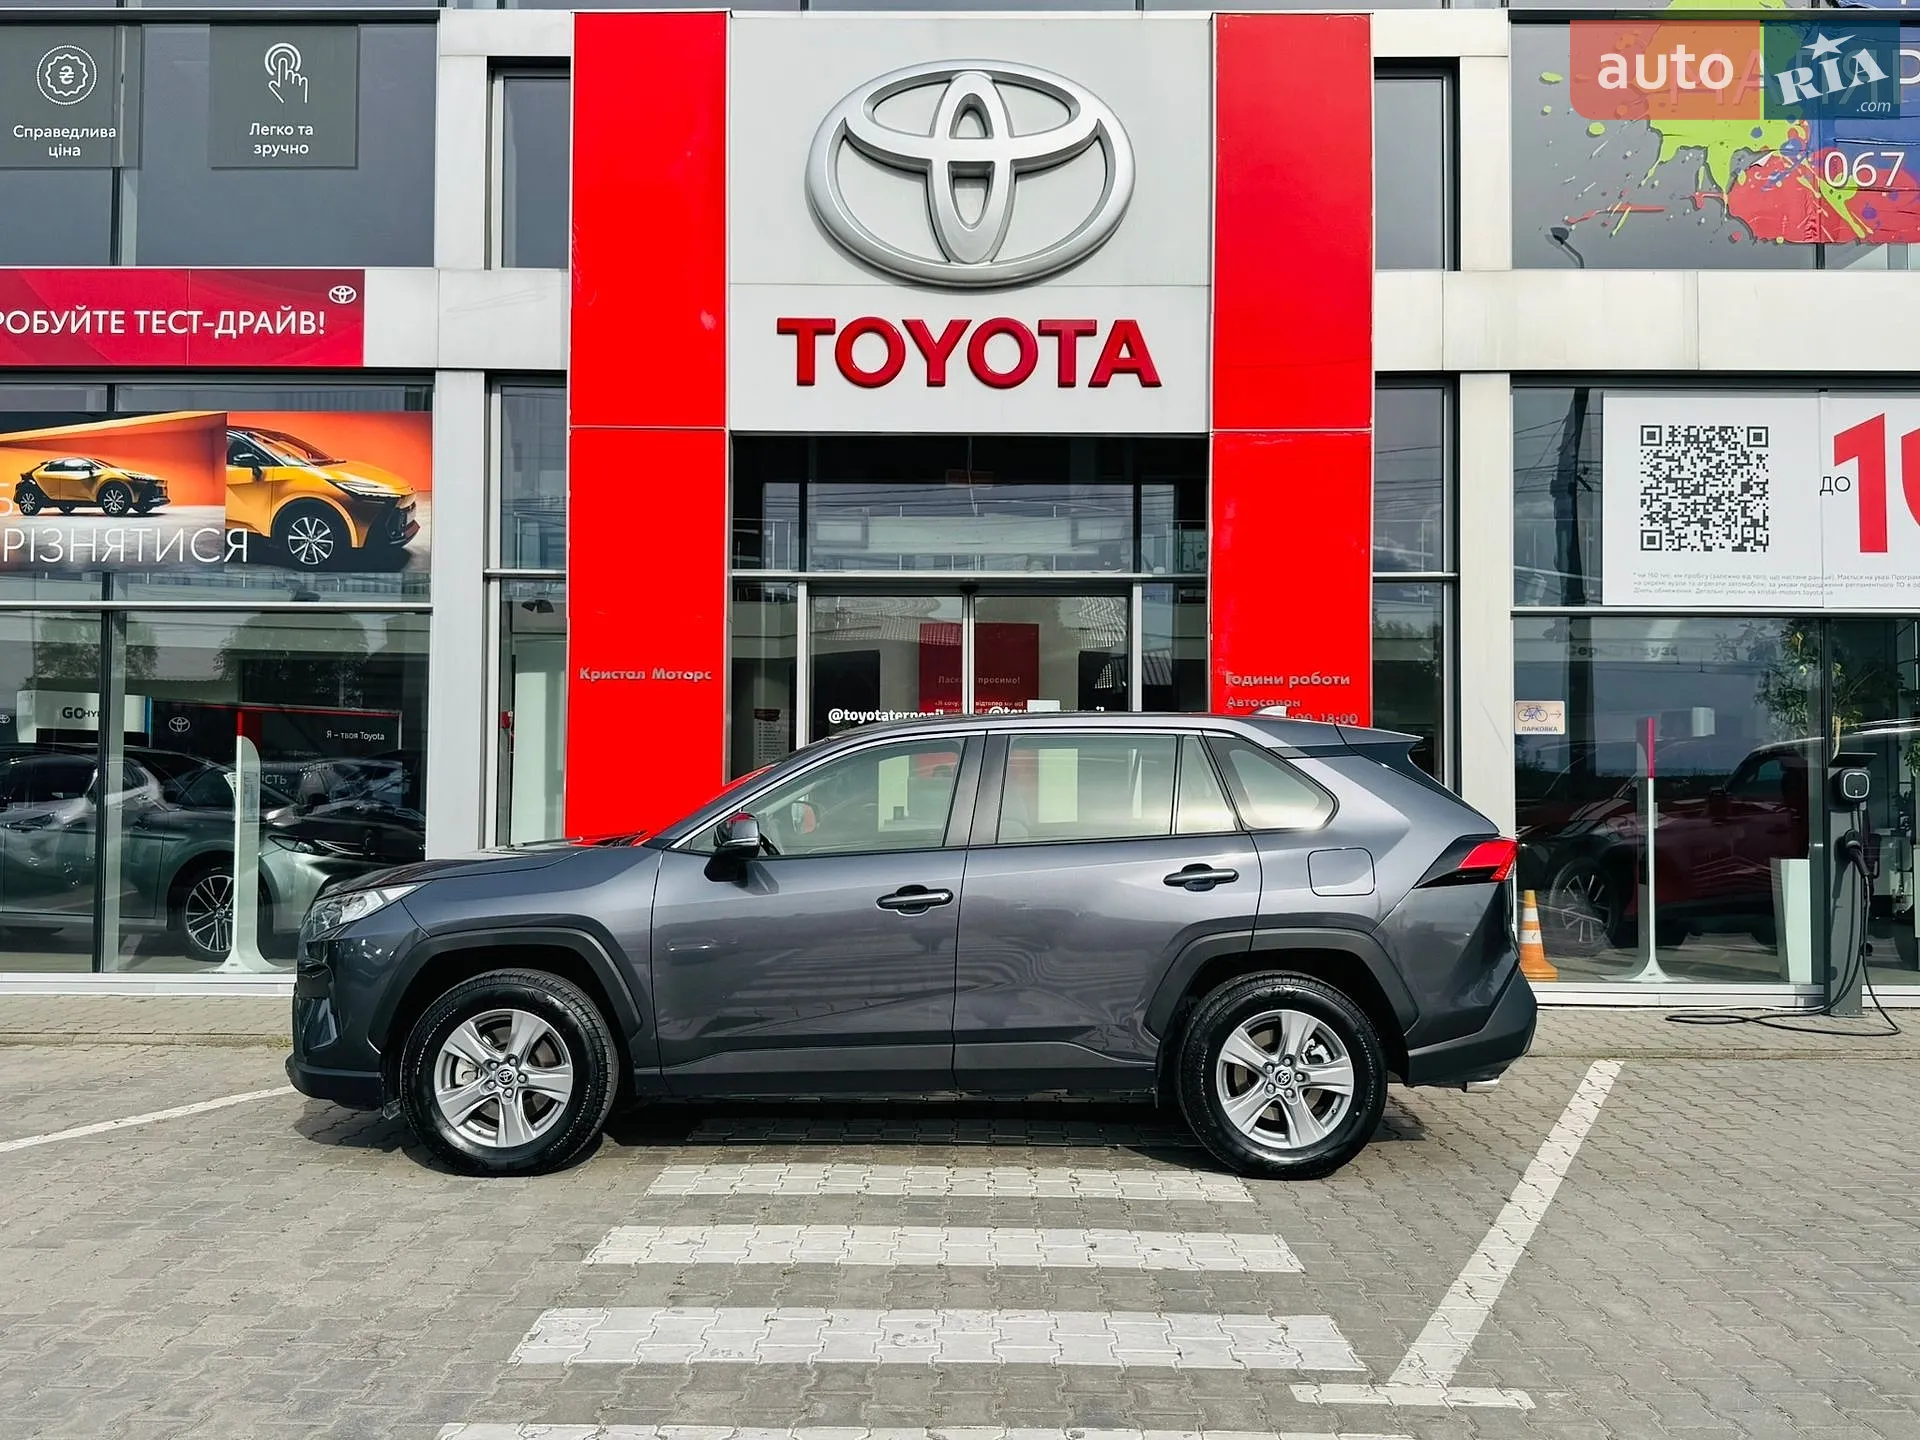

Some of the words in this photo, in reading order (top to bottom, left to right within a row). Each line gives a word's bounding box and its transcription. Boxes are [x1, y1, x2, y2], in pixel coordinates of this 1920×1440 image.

[13, 124, 117, 141] Справедлива
[249, 122, 294, 136] Легко
[298, 125, 314, 136] та
[48, 143, 81, 158] ціна
[253, 143, 309, 157] зручно
[1823, 151, 1906, 188] 067
[134, 304, 325, 339] ТЕСТ-ДРАЙВ!
[776, 316, 1163, 390] TOYOTA
[1834, 412, 1920, 553] 1
[3, 526, 249, 563] РІЗНЯТИСЯ
[579, 667, 646, 682] Кристал
[652, 667, 712, 682] Моторс
[1225, 671, 1284, 687] Години
[1289, 671, 1350, 688] роботи
[62, 707, 85, 719] GO
[360, 731, 385, 742] Toyota
